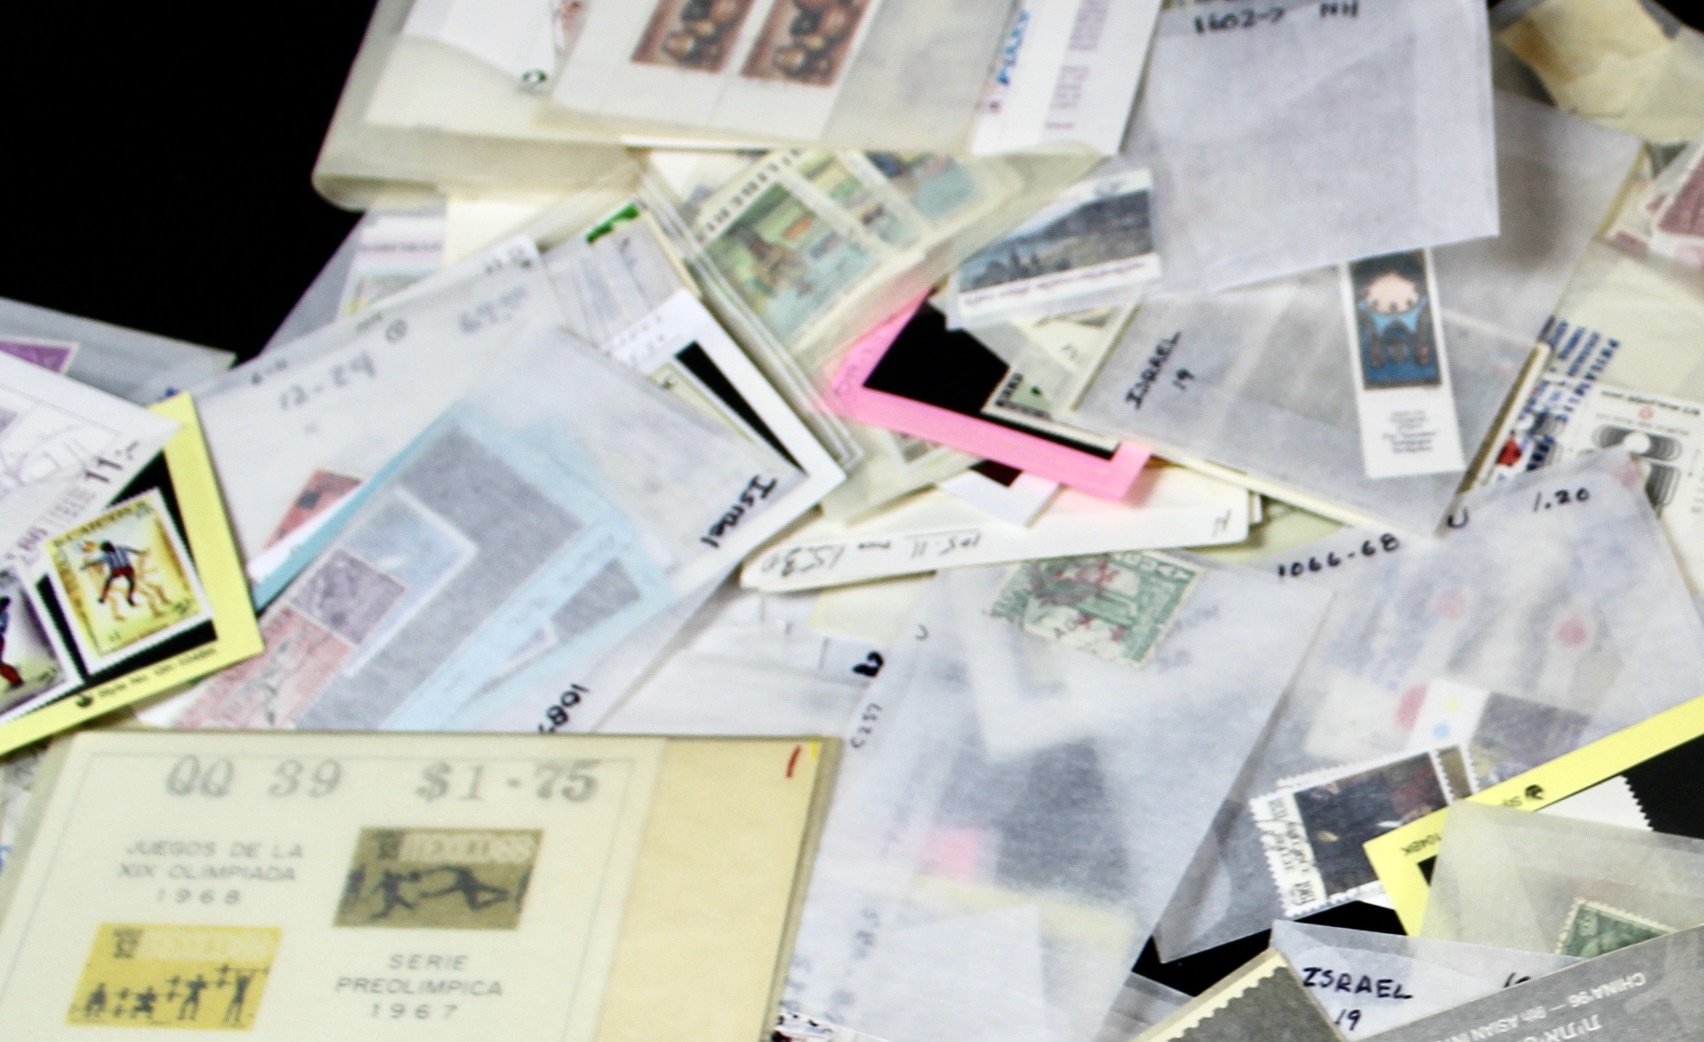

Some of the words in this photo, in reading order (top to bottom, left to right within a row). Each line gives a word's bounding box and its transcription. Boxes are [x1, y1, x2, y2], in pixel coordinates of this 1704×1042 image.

[267, 759, 343, 801] 39
[126, 840, 218, 860] JUEGOS
[230, 841, 263, 860] DE
[272, 842, 305, 860] LA
[118, 863, 157, 881] XIX
[168, 864, 298, 884] OLIMPIADA
[157, 888, 244, 907] 1968
[388, 952, 471, 975] SERIE
[335, 976, 504, 1000] PREOLIMPICA
[1301, 966, 1414, 1001] ISRAEL
[369, 1002, 460, 1022] 1967
[1334, 1008, 1362, 1032] 19
